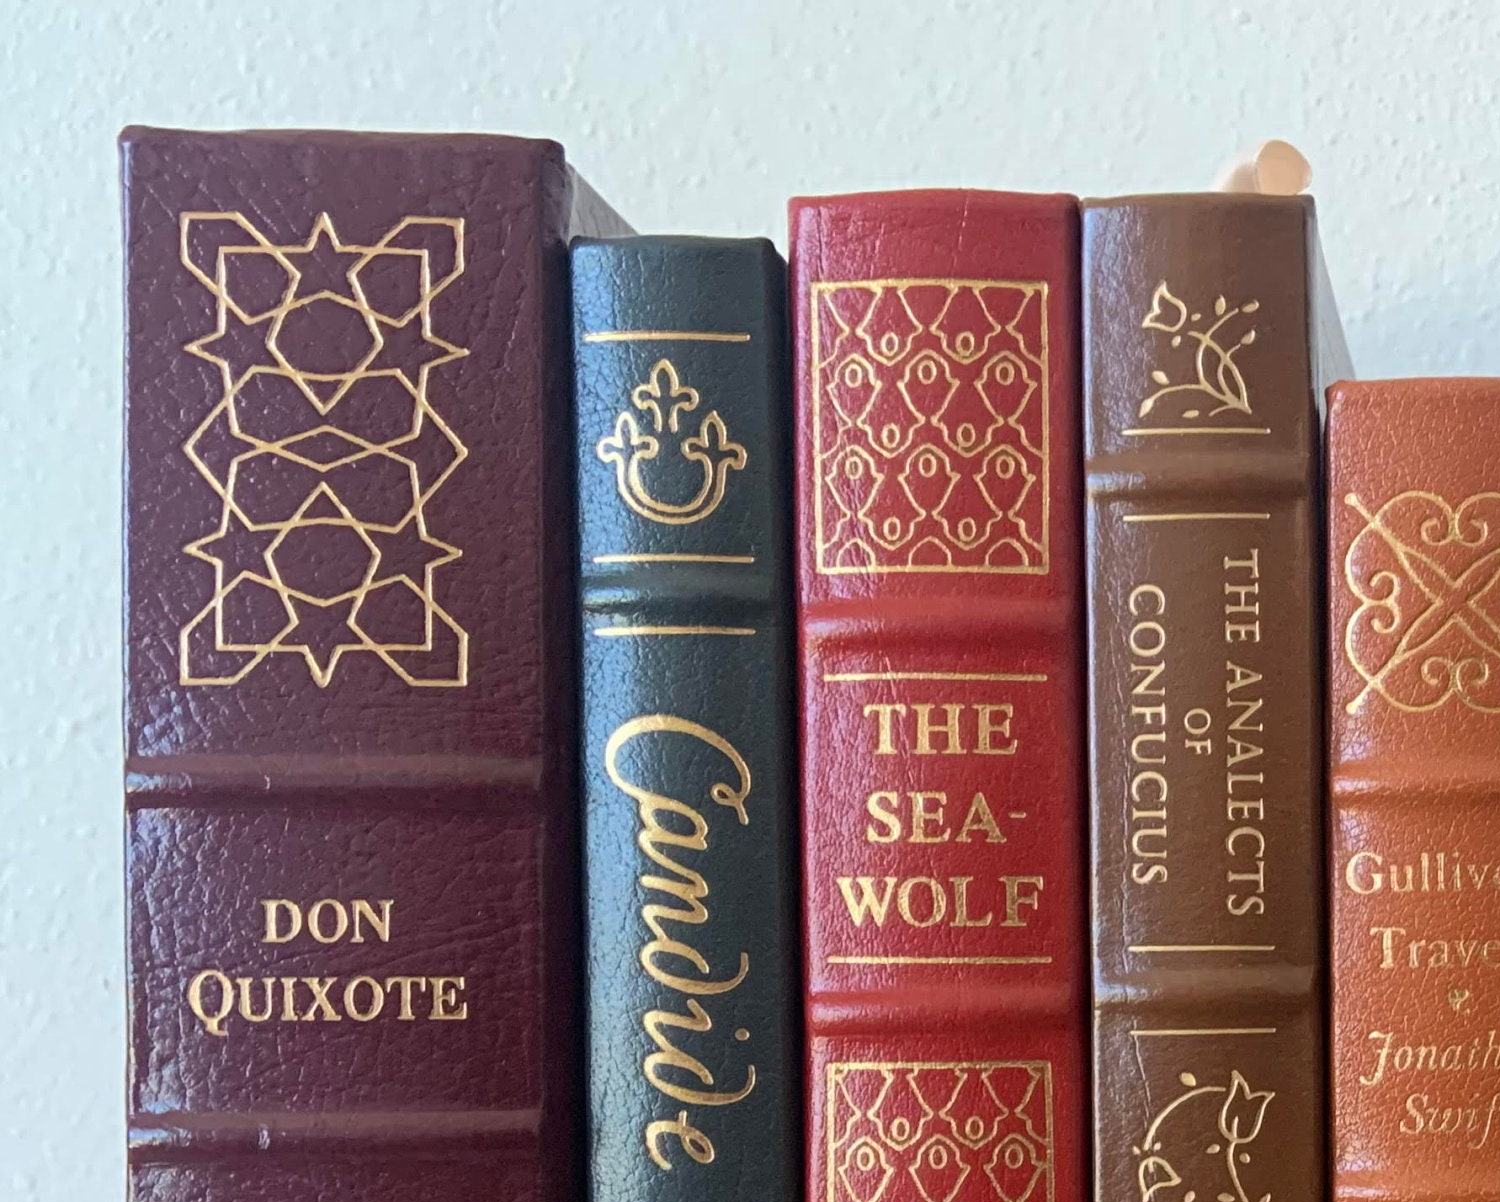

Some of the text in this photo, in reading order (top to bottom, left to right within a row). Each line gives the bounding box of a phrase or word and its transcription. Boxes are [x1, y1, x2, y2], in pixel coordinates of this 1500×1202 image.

[862, 702, 1018, 755] THE
[1129, 583, 1168, 884] CONFUCIUS
[1183, 707, 1212, 757] OF
[1223, 548, 1265, 916] THE ANALECTS
[866, 790, 1027, 844] SEA-
[260, 897, 395, 945] DON
[836, 876, 1044, 928] WOLF
[604, 713, 756, 1171] Candide
[188, 968, 469, 1037] QUIXOTE
